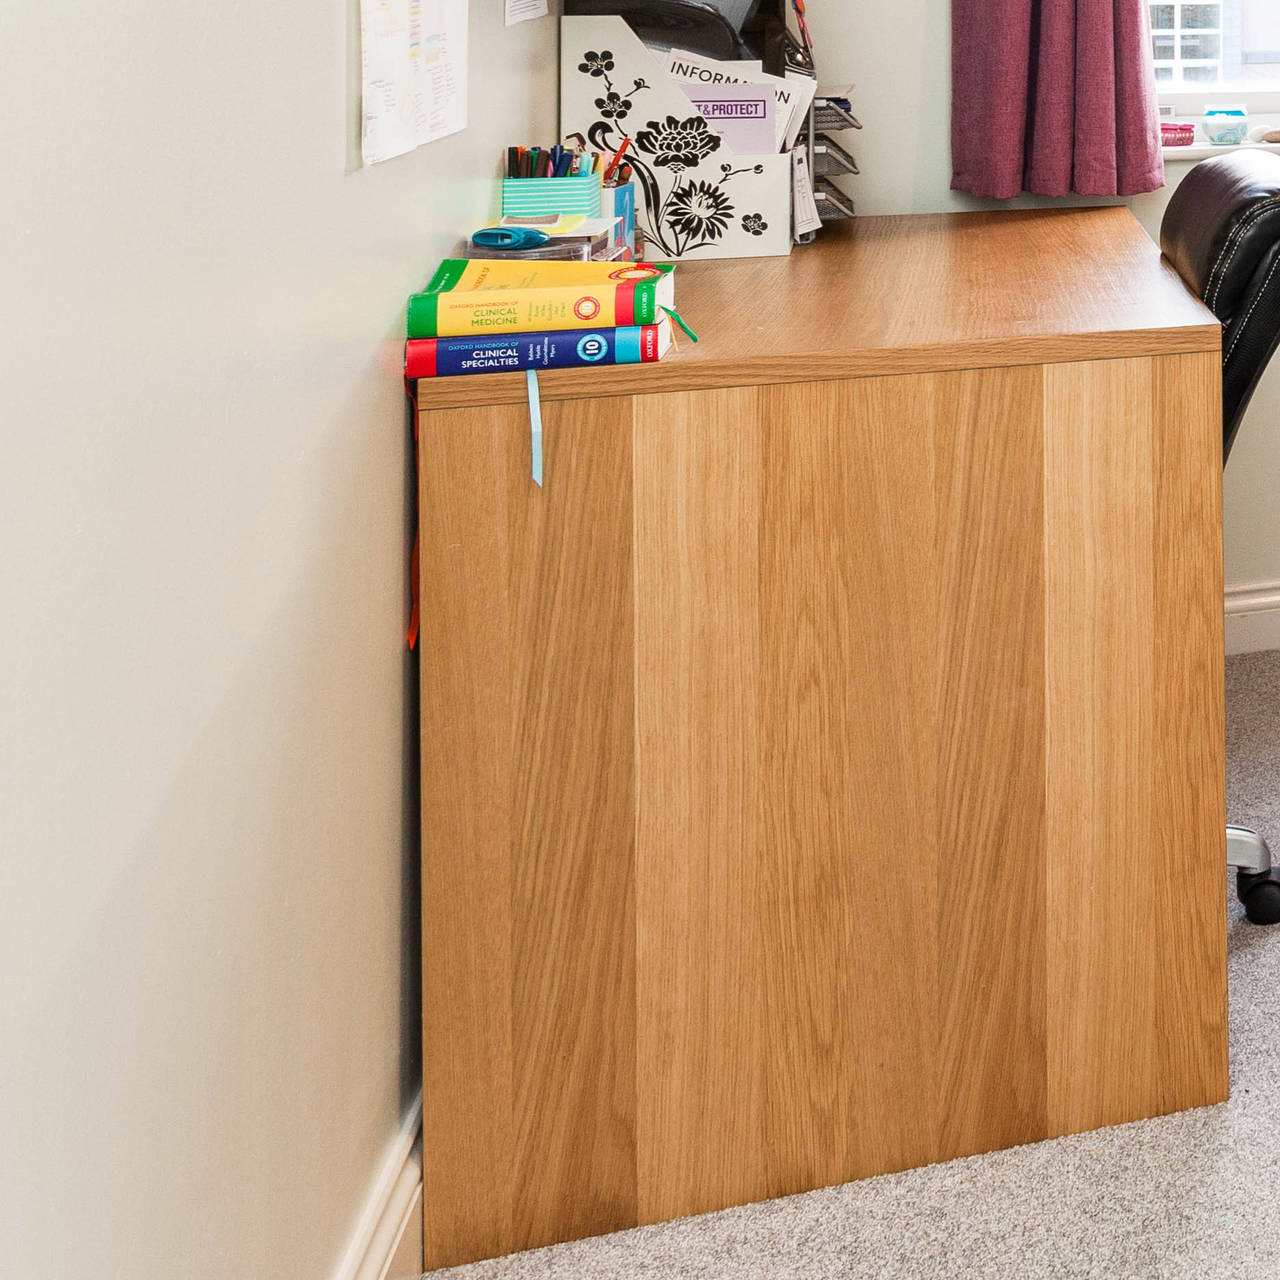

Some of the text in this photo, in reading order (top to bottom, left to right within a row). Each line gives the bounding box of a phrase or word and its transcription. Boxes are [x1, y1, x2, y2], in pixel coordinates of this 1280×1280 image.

[473, 308, 518, 318] CLINICAL
[471, 317, 519, 327] MEDICINE
[474, 342, 509, 350] HANDBOOK
[585, 341, 600, 354] 10
[472, 349, 519, 359] CLINICAL
[461, 357, 519, 369] SPECIALTIES
